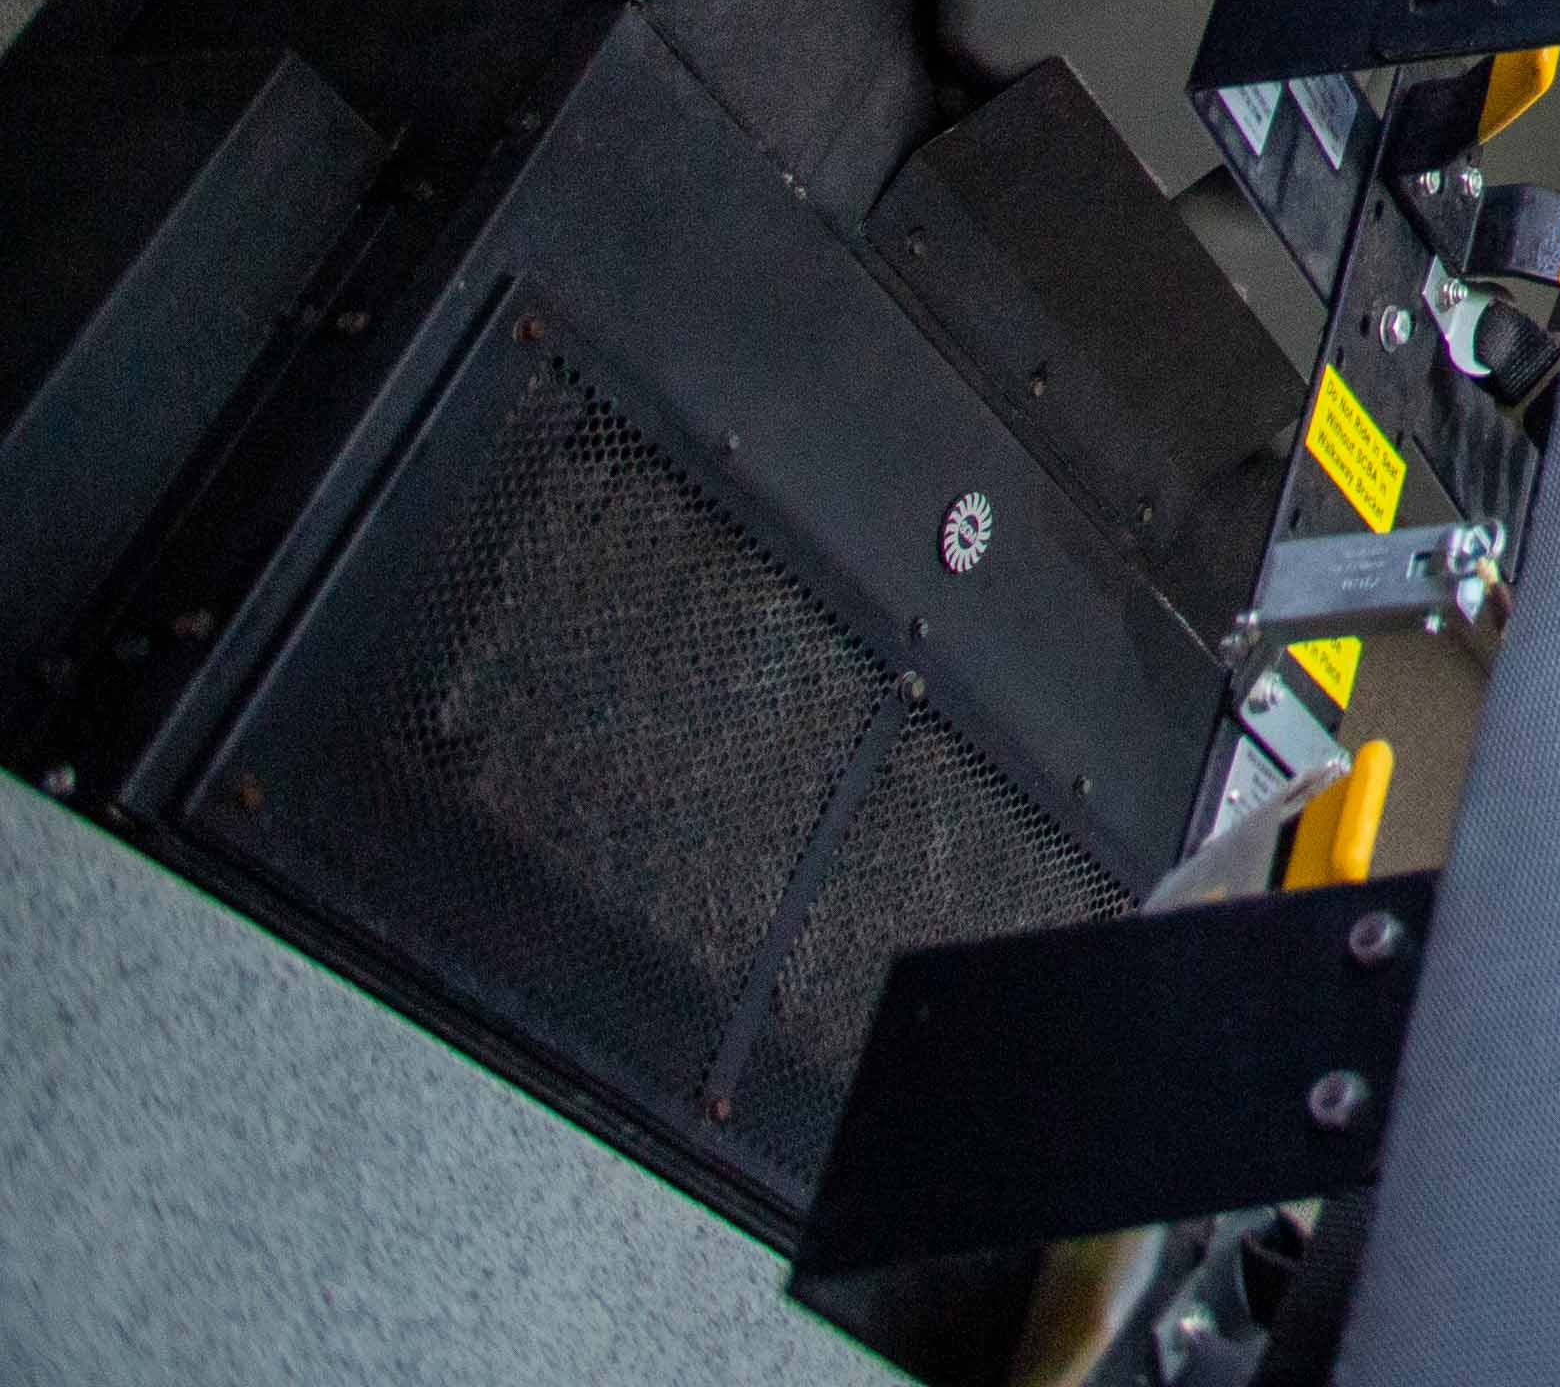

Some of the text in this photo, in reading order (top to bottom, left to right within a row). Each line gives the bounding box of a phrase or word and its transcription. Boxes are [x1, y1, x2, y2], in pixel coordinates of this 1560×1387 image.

[1325, 409, 1355, 452] Without
[1356, 448, 1377, 483] SCBA
[1326, 378, 1337, 402] Do
[1339, 398, 1353, 419] Not
[1382, 451, 1398, 478] Seat
[1316, 429, 1353, 485] Walkaway
[1355, 478, 1384, 522] Bracket
